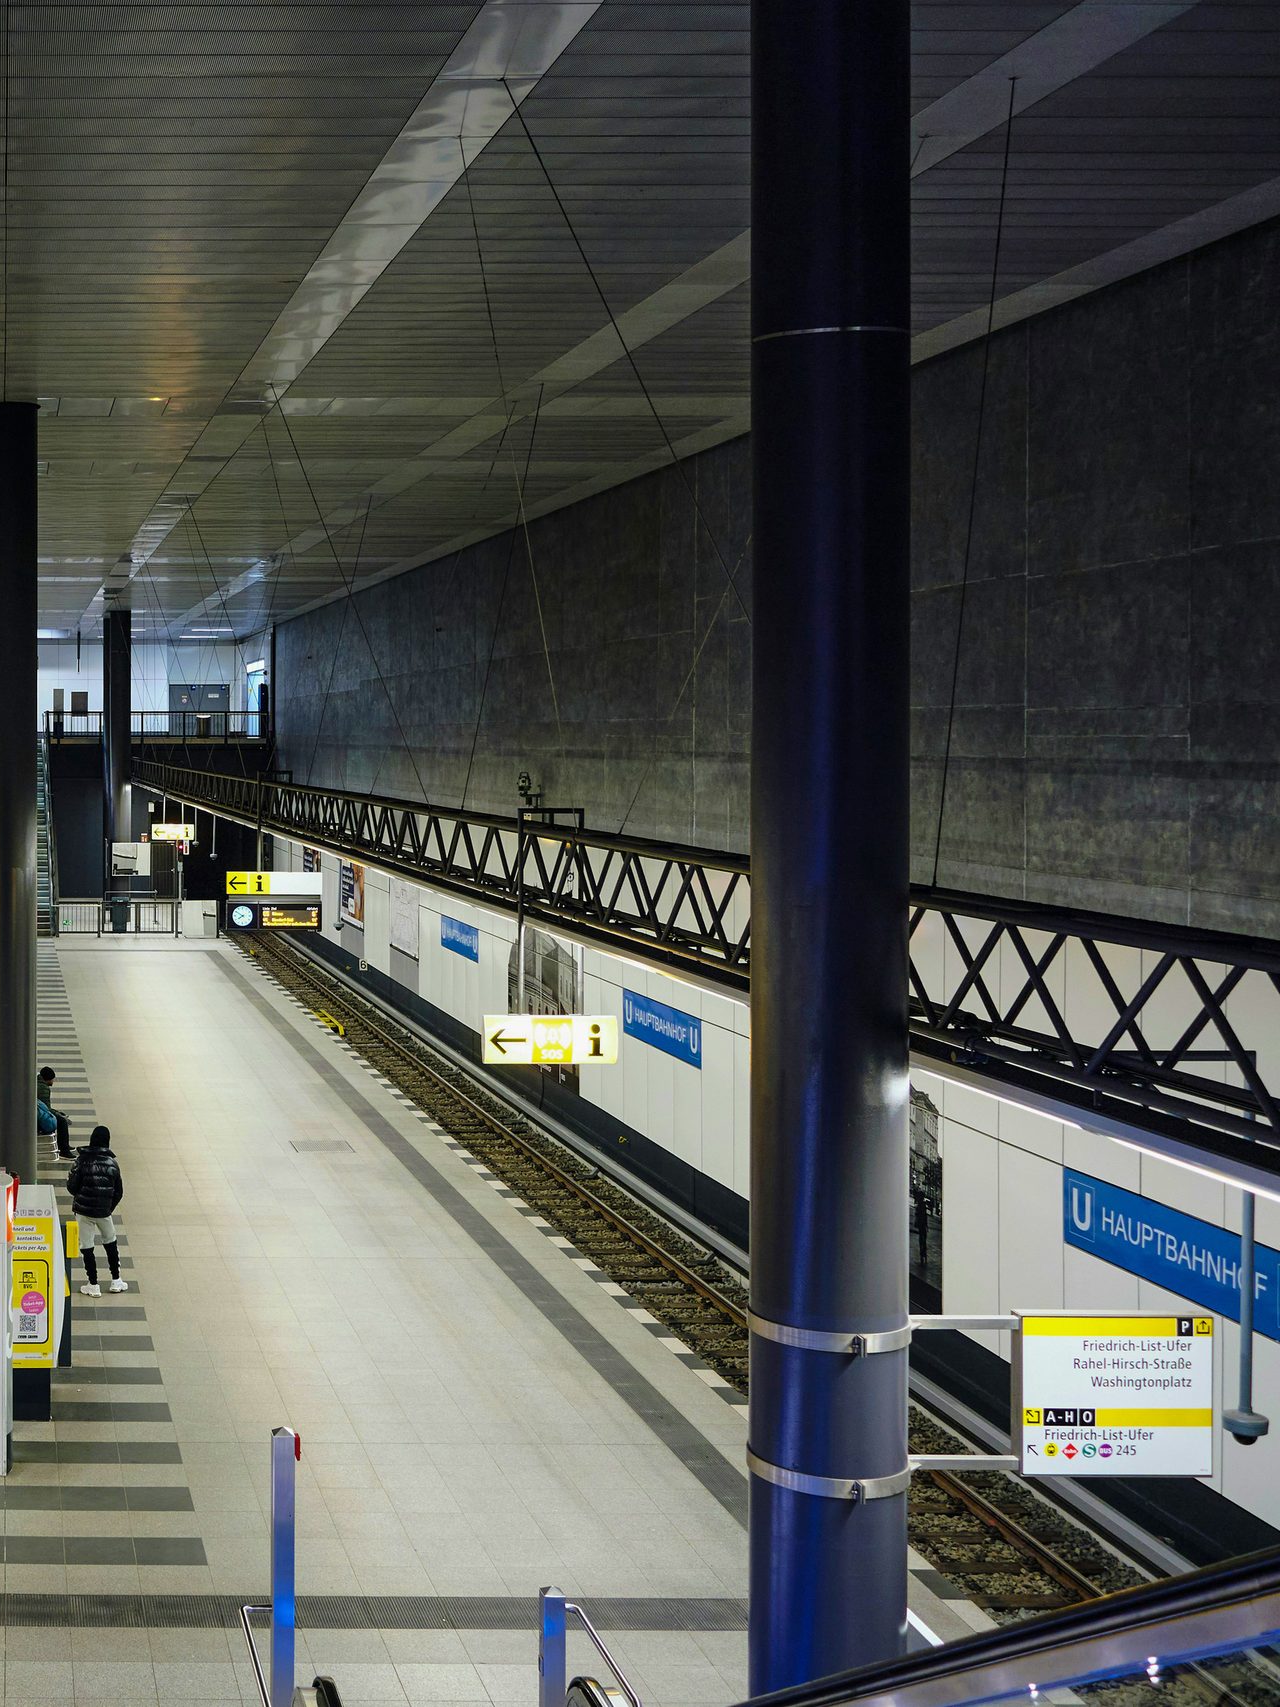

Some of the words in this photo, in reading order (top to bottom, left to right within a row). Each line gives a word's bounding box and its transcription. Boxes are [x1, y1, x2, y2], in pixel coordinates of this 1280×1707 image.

[360, 960, 367, 970] 6
[625, 999, 633, 1024] U
[634, 1007, 687, 1044] HAUPTBAHNHOF
[689, 1026, 698, 1054] U
[541, 1049, 563, 1060] SOS
[1072, 1187, 1091, 1232] U
[1181, 1320, 1190, 1333] P
[1083, 1340, 1192, 1351] Friedrich-List-Ufer
[1073, 1358, 1192, 1369] Rahel-Hirsch-Straße
[1091, 1376, 1192, 1391] Washingtonplatz
[1044, 1429, 1154, 1441] Friedrich-List-Ufer
[1116, 1445, 1136, 1456] 245
